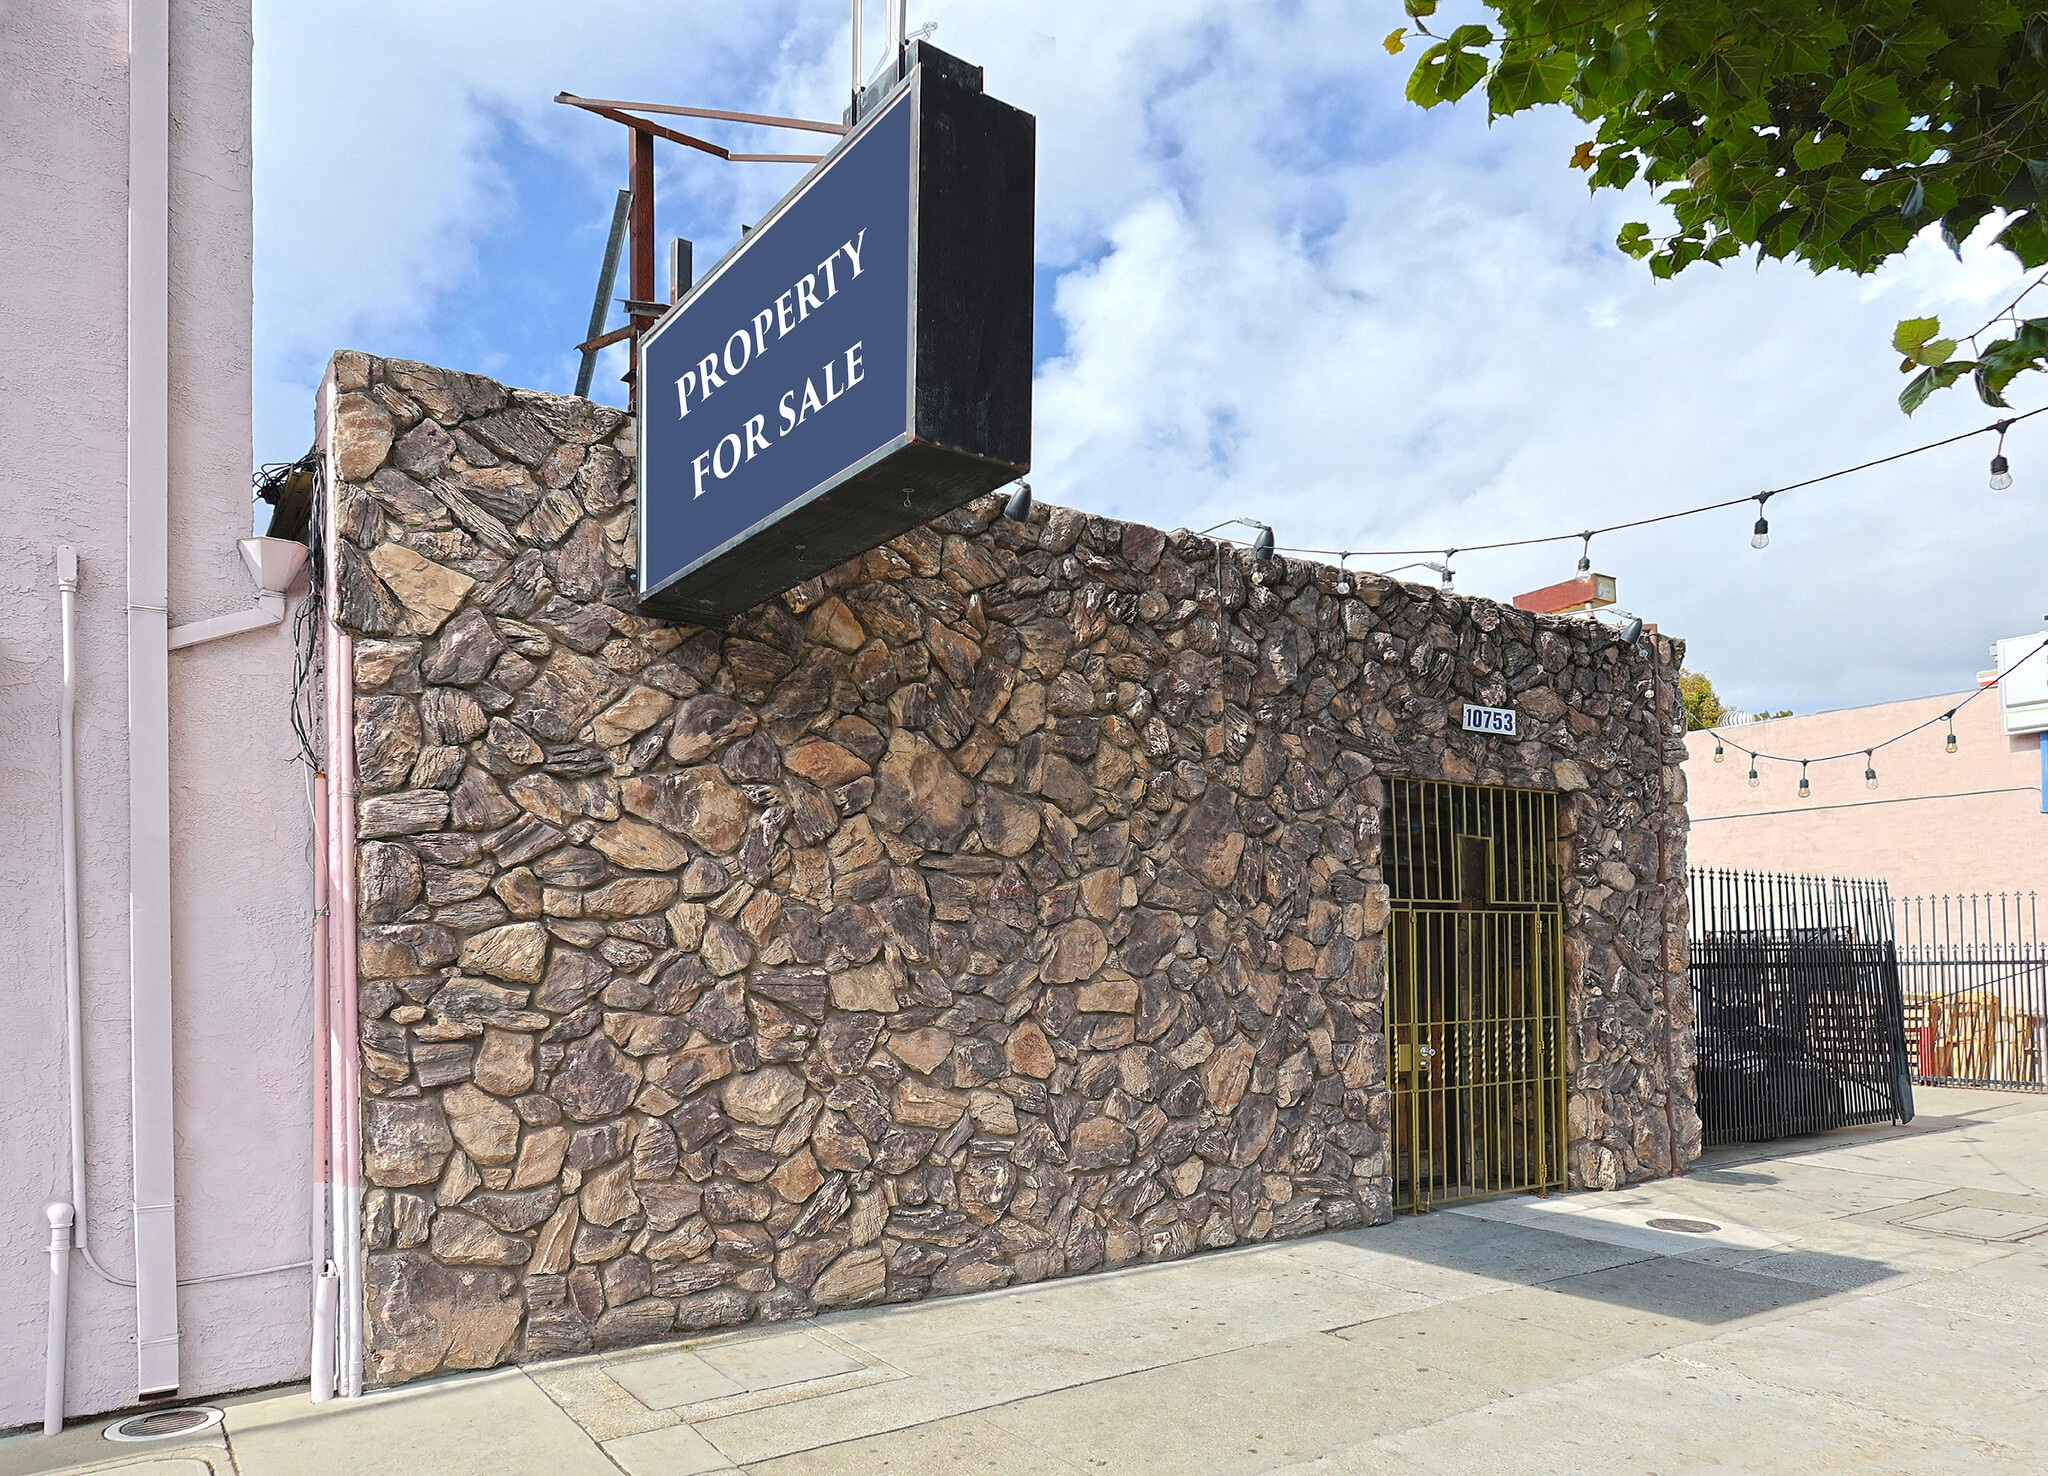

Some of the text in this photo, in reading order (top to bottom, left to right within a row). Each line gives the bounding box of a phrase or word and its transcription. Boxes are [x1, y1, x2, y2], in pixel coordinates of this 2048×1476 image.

[674, 227, 867, 421] PROPERTY
[691, 340, 865, 500] FOR SALE
[1466, 708, 1513, 731] 10753
